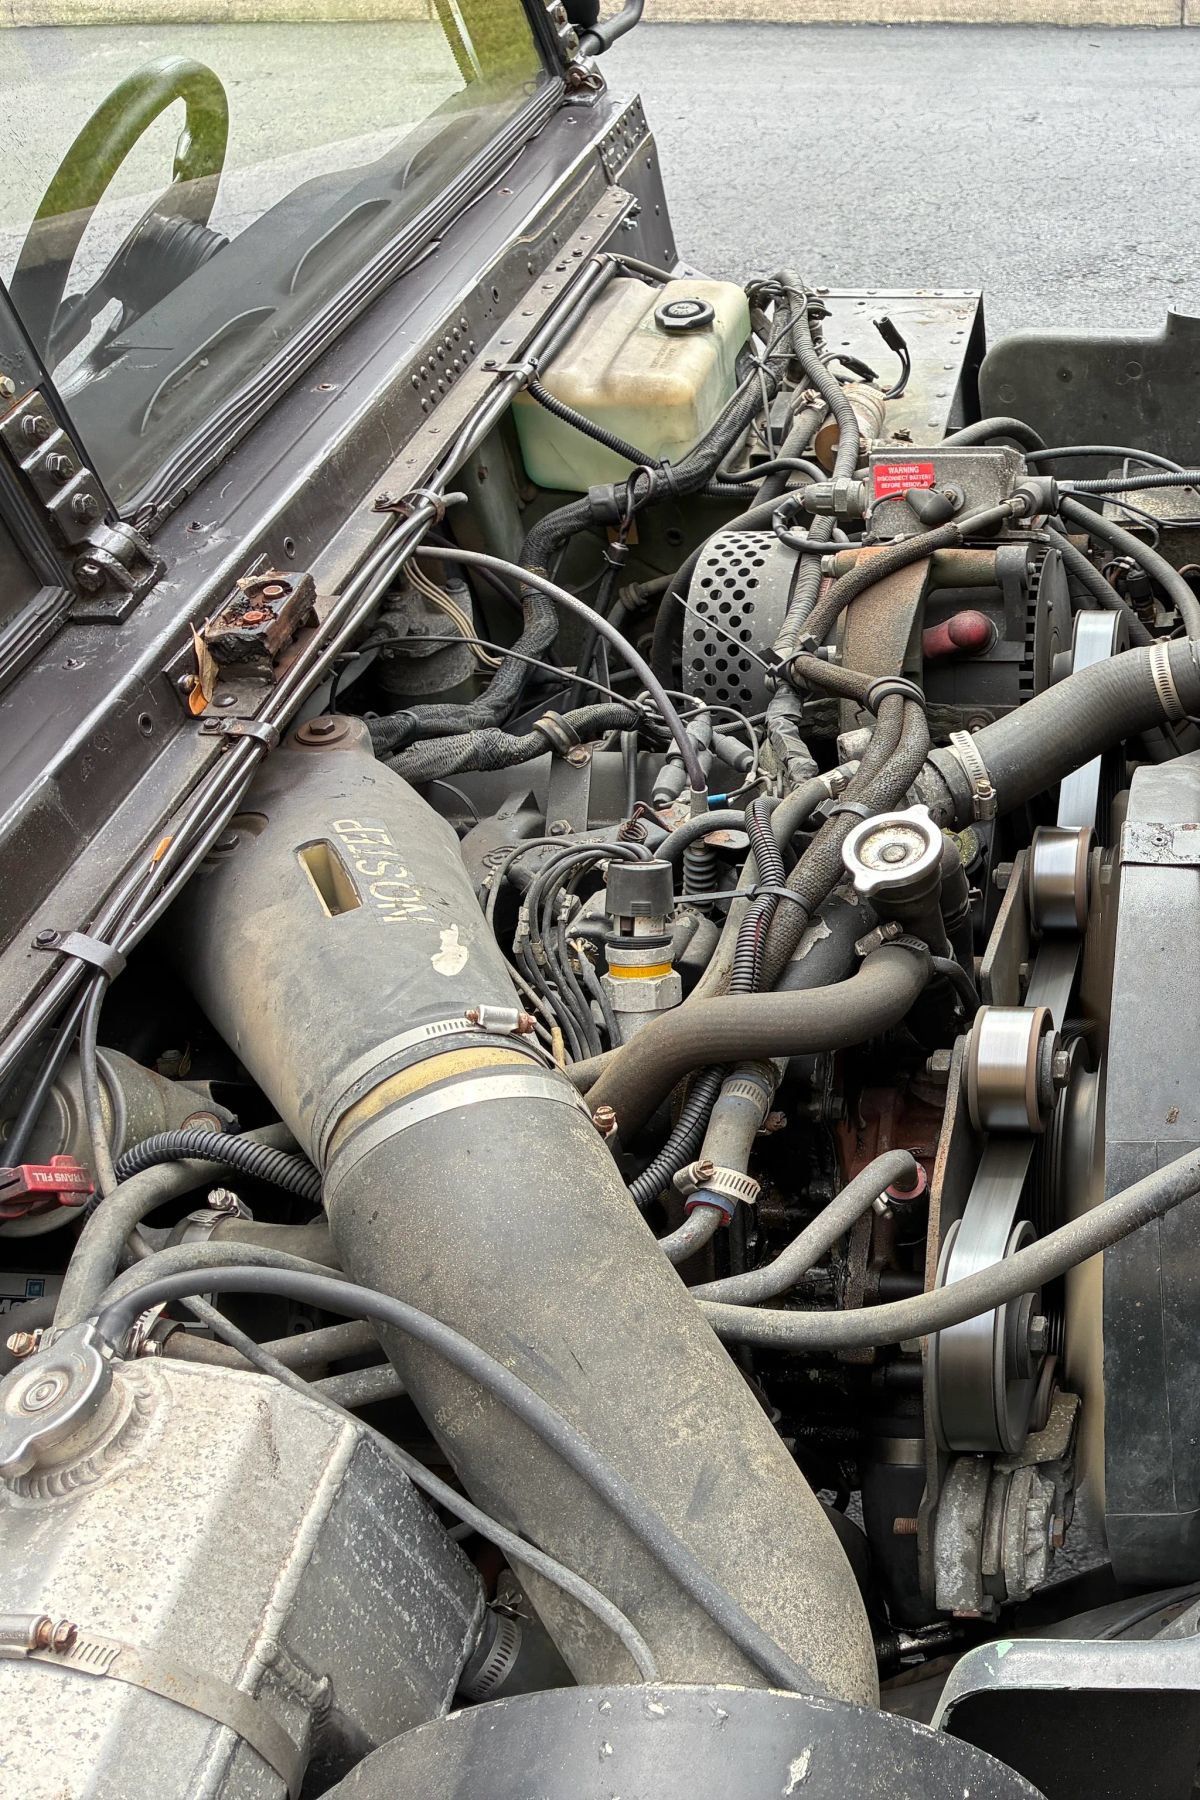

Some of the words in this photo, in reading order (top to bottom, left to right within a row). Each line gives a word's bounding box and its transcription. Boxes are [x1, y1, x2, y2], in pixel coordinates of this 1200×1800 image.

[887, 465, 920, 474] WARNING
[876, 474, 909, 482] DISCONNECT
[909, 473, 931, 481] BATTERY
[881, 481, 901, 489] BEFORE
[32, 1172, 53, 1182] FILL
[55, 1172, 86, 1183] TRANS
